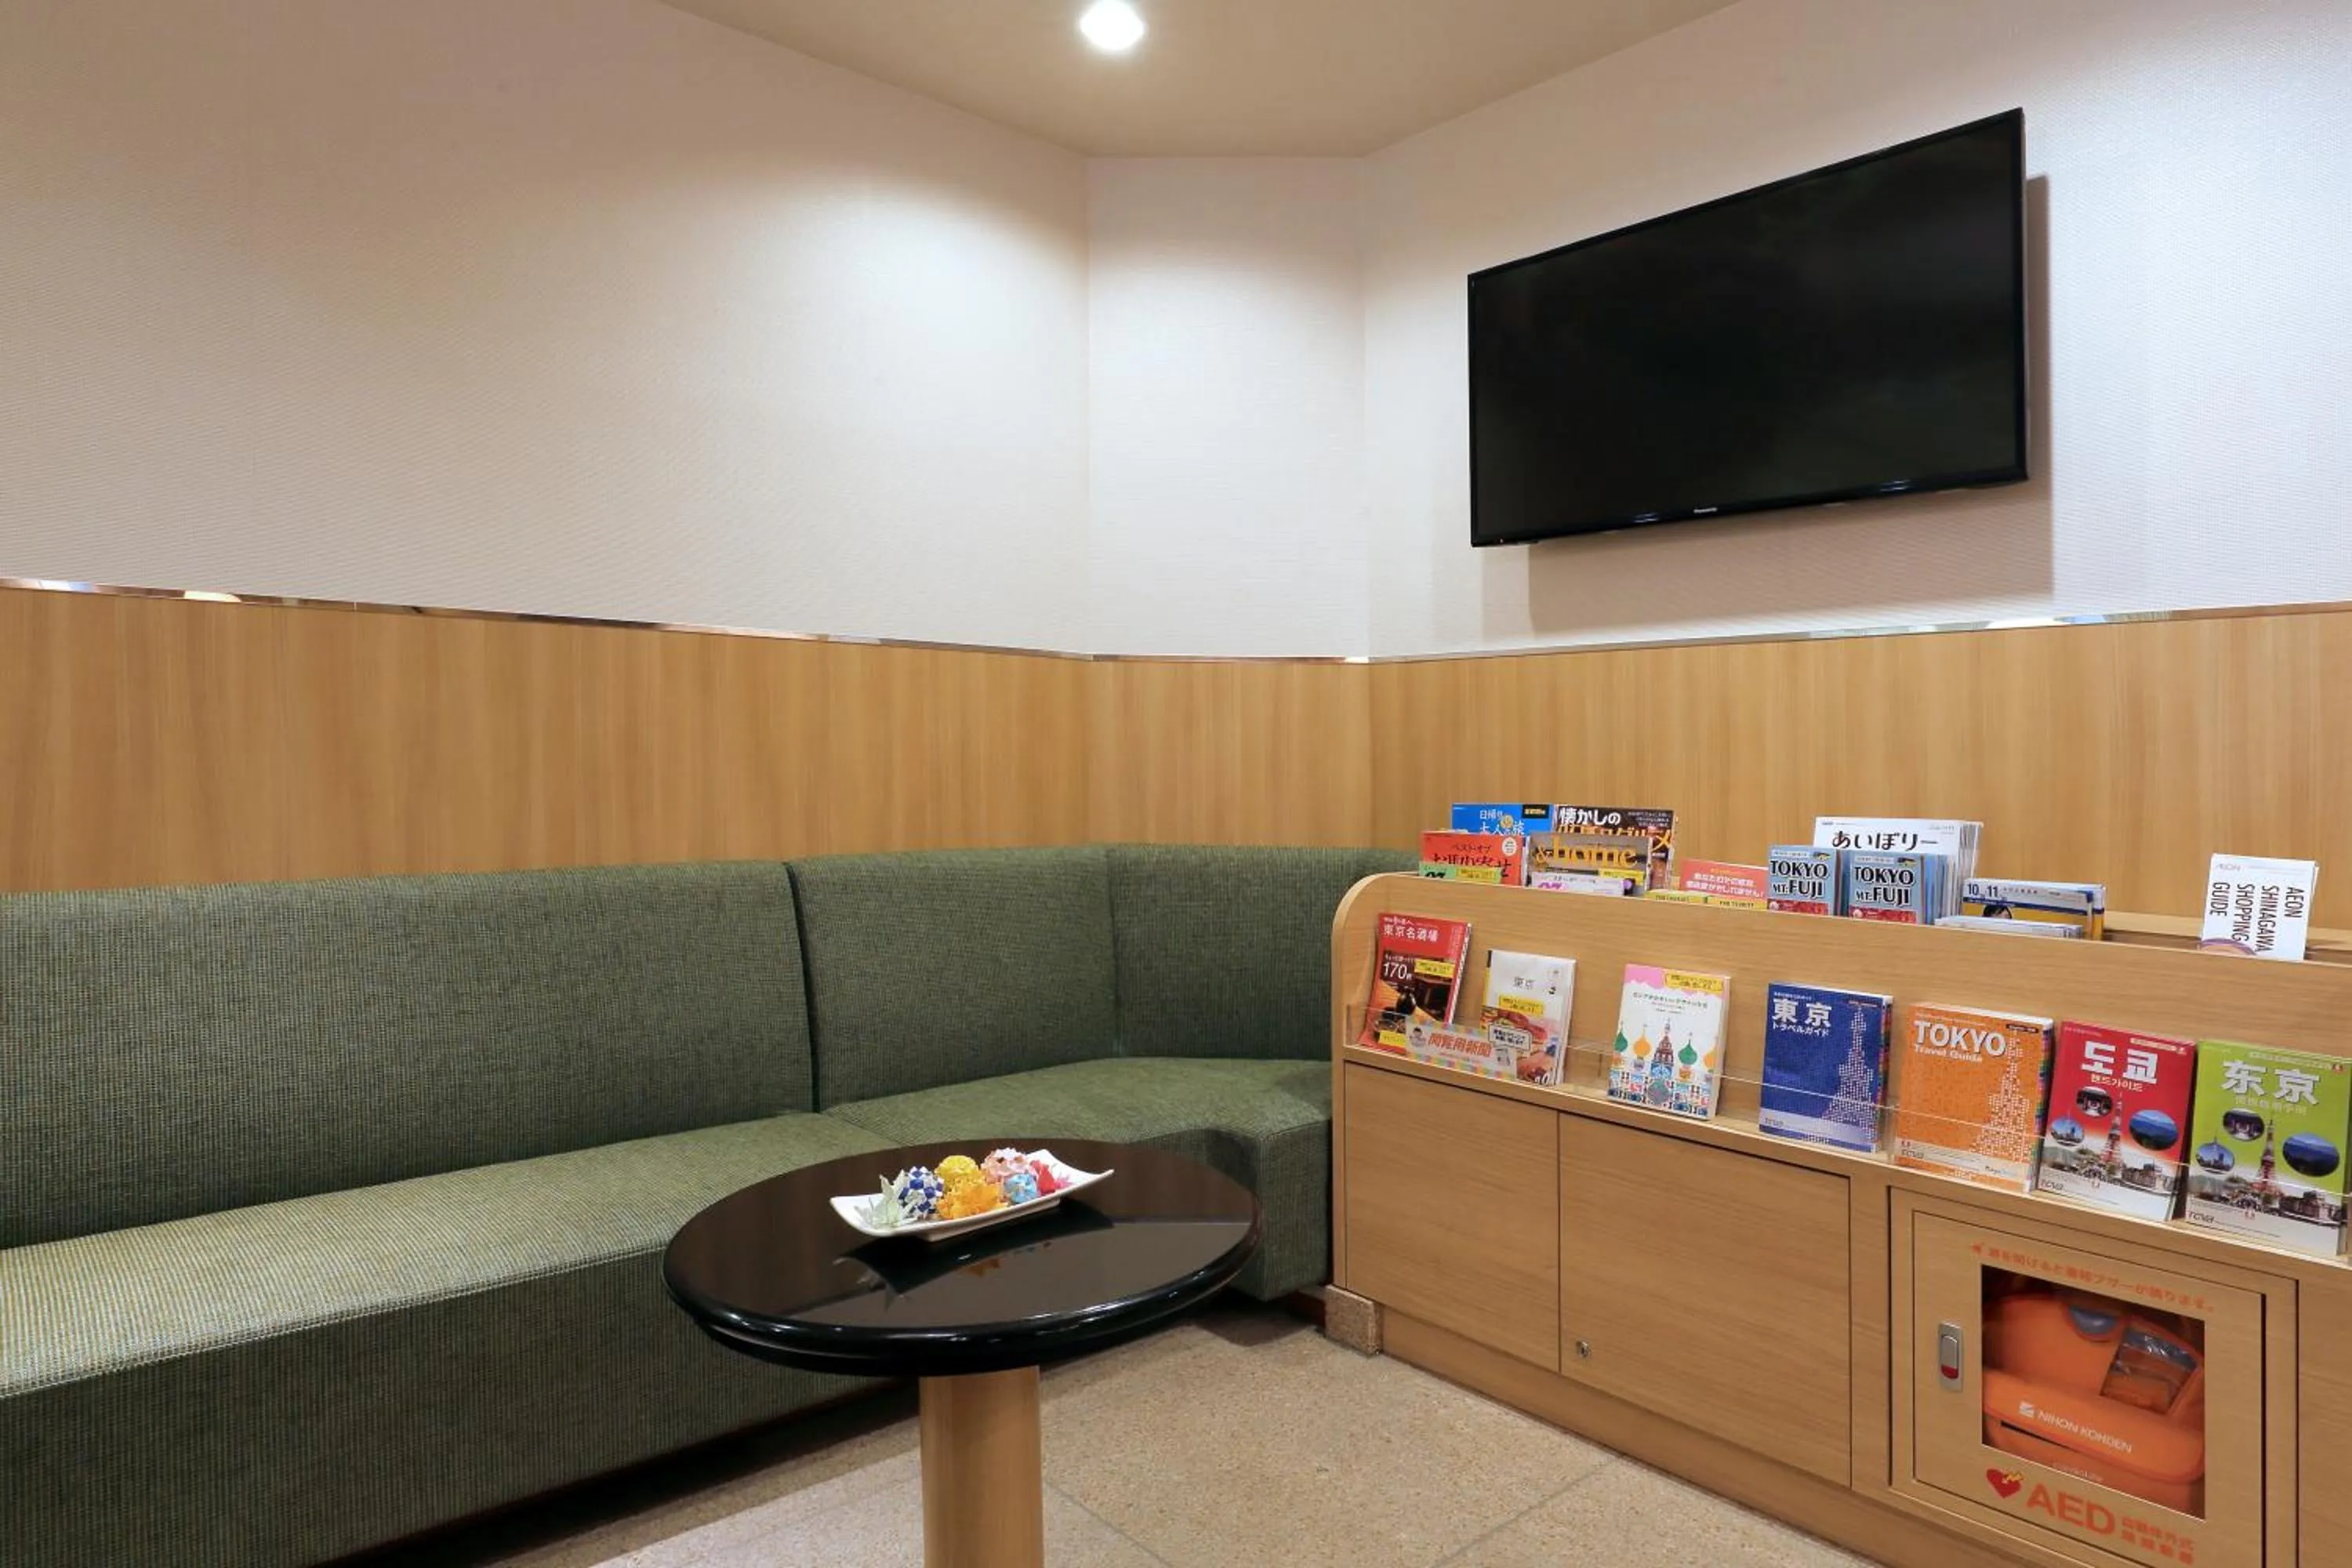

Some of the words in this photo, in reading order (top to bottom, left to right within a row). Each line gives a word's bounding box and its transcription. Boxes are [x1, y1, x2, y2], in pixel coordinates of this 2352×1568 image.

[1559, 808, 1621, 826] 懐かしの
[1832, 830, 1939, 851] あいぼりー
[1770, 860, 1828, 879] TOKYO
[1854, 866, 1915, 886] TOKYO
[2209, 881, 2230, 916] GUIDE
[2230, 884, 2256, 942] SHOPPING
[2284, 887, 2305, 919] AEON
[2254, 885, 2280, 953] SHINAGAWA
[1772, 997, 1833, 1028] 東京
[1773, 1022, 1830, 1037] トラベルガイド
[1914, 1020, 2007, 1057] TOKYO
[1915, 1044, 1947, 1058] Travel
[1950, 1050, 1983, 1063] Guide
[2082, 1040, 2158, 1084] 도쿄
[2220, 1060, 2321, 1105] 东京
[2038, 1410, 2078, 1433] NIHON
[2080, 1426, 2132, 1453] KOHDEN
[2026, 1480, 2115, 1535] AED
